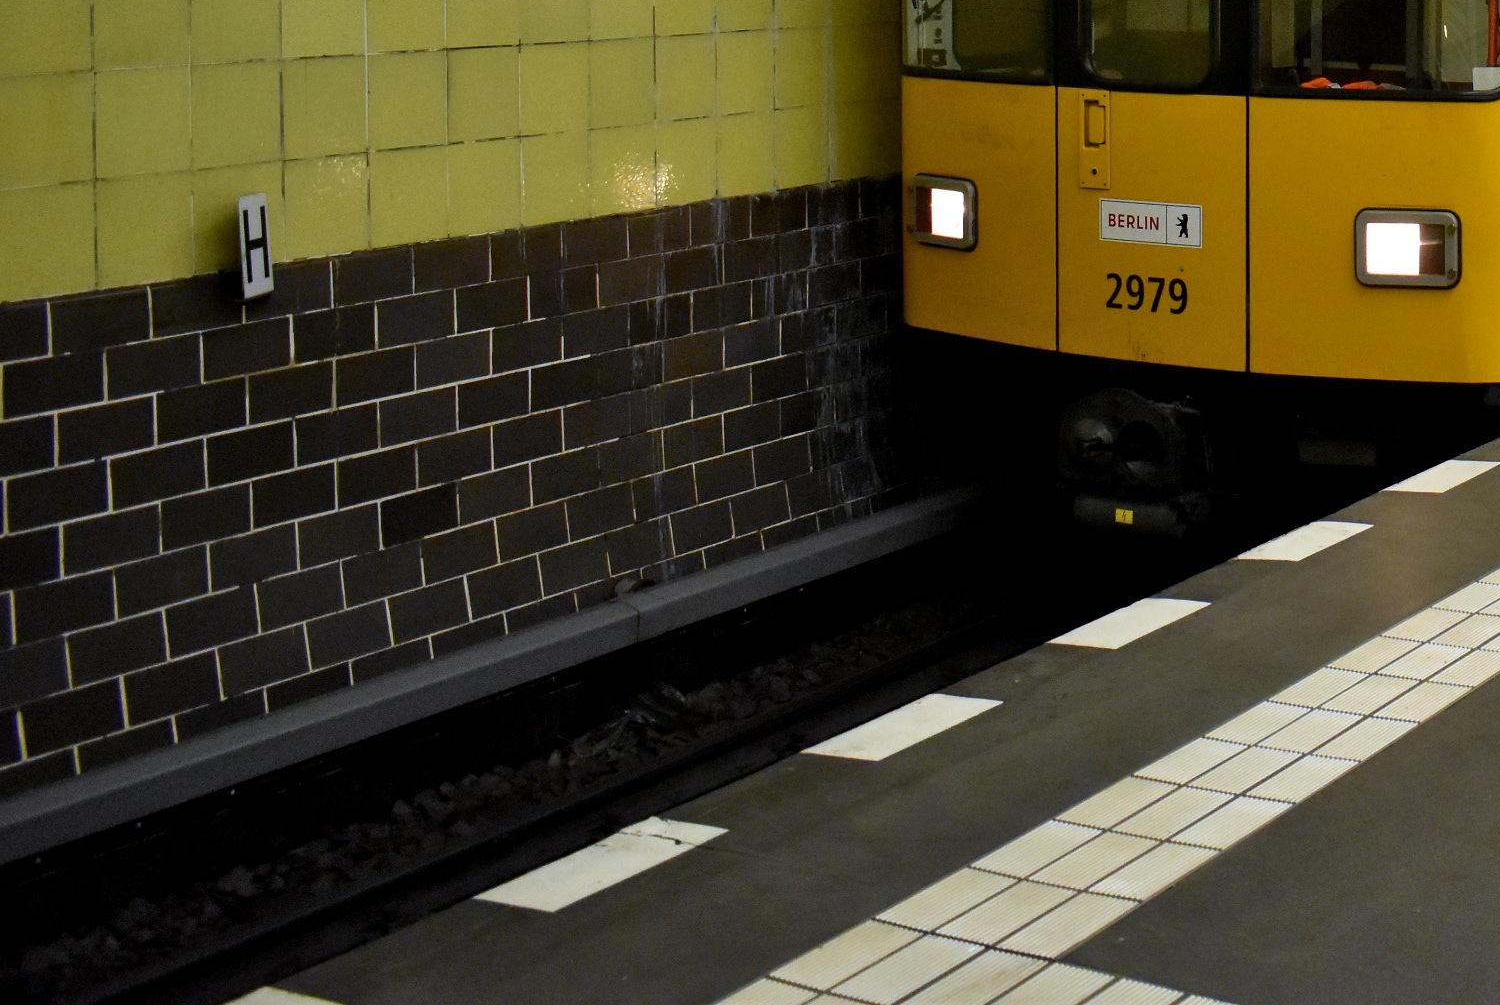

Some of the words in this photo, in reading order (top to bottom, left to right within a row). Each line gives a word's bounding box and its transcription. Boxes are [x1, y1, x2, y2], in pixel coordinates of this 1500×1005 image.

[1108, 213, 1160, 231] BERLIN
[243, 205, 270, 284] H
[1106, 272, 1188, 314] 2979
